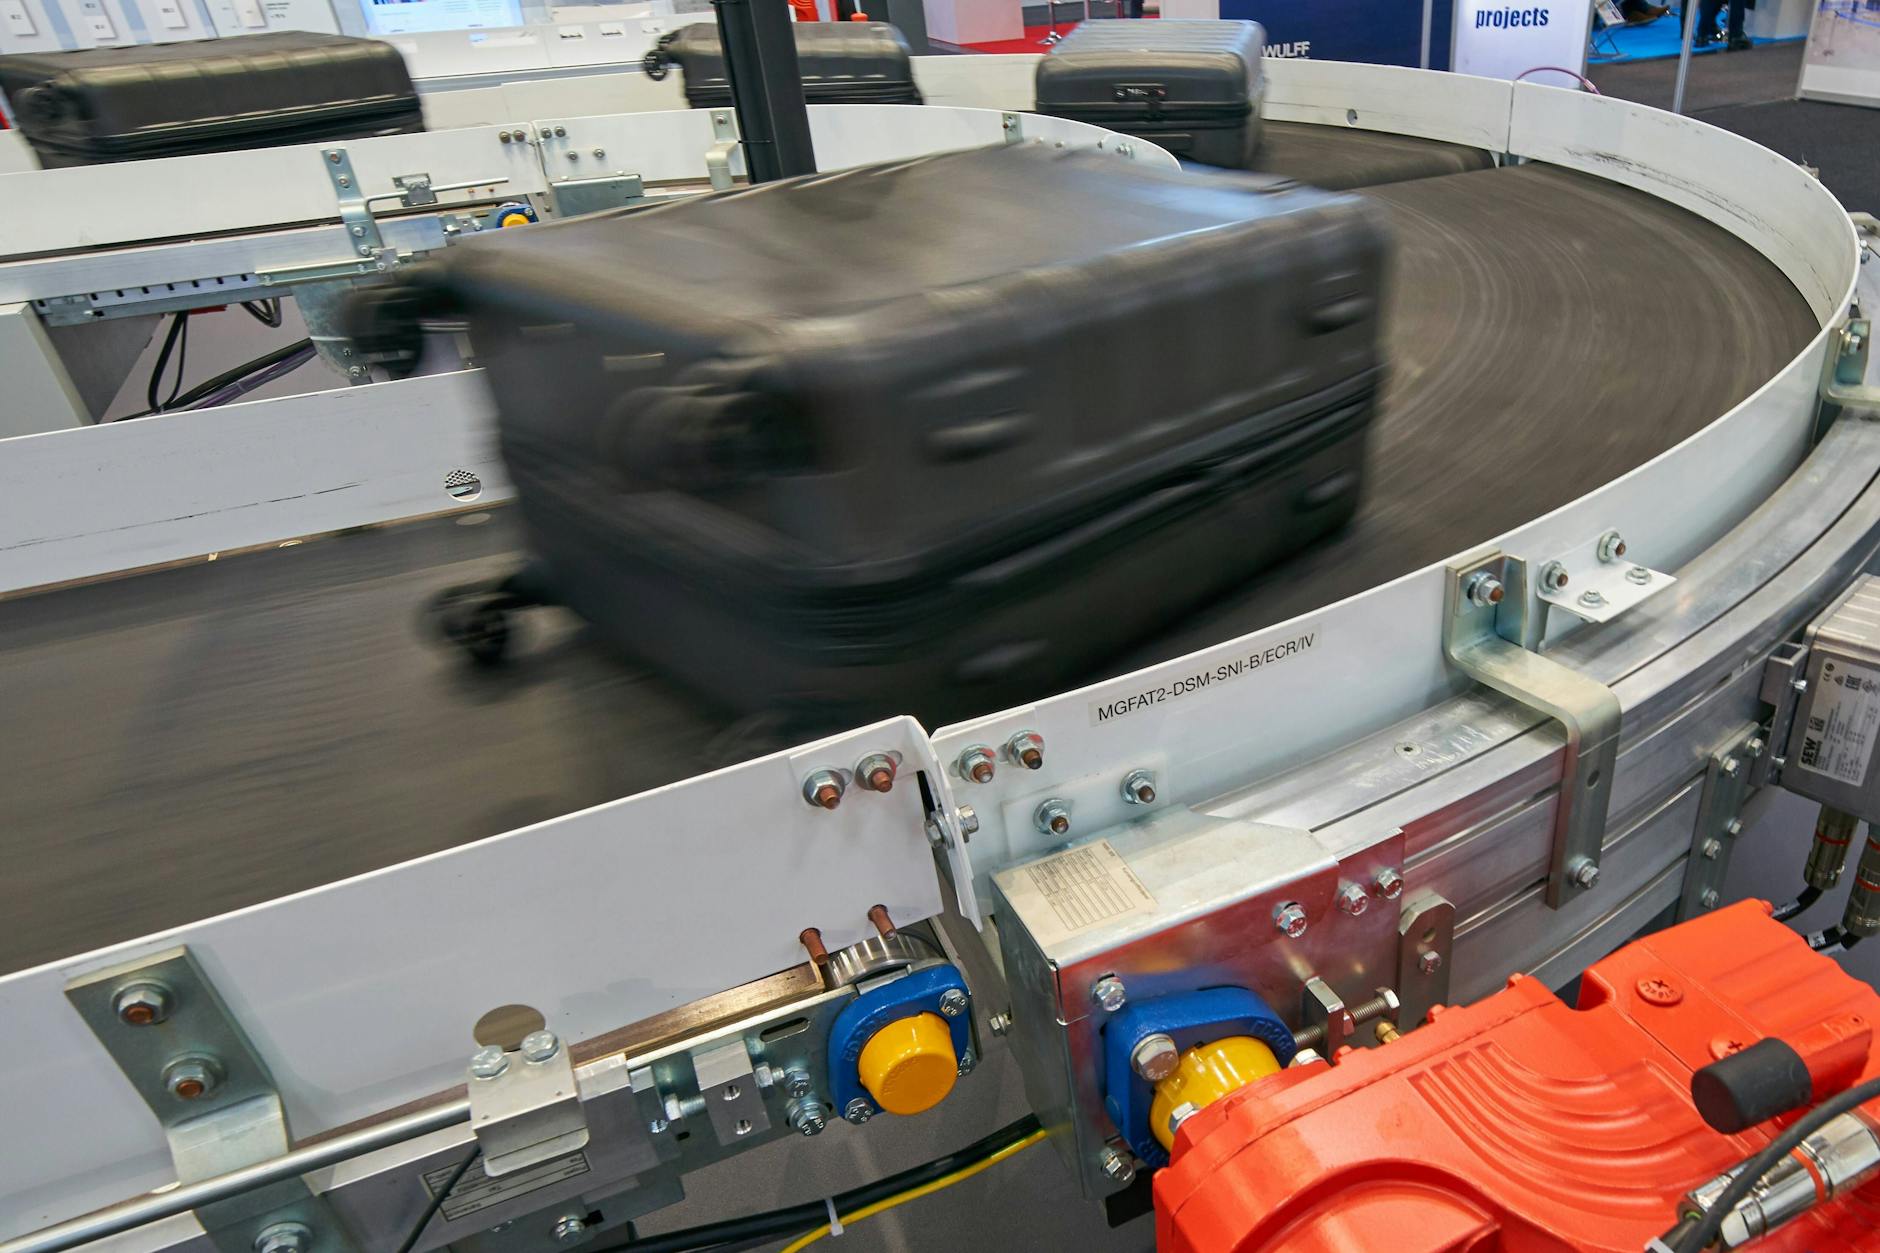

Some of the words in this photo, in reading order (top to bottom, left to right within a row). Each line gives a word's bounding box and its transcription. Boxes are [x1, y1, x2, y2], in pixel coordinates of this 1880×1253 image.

[1475, 6, 1549, 29] projects
[1262, 41, 1310, 58] WULFF
[1098, 633, 1314, 721] MGFAT2-DSM-SNI-B/ECR/IV
[1801, 736, 1816, 766] SEW
